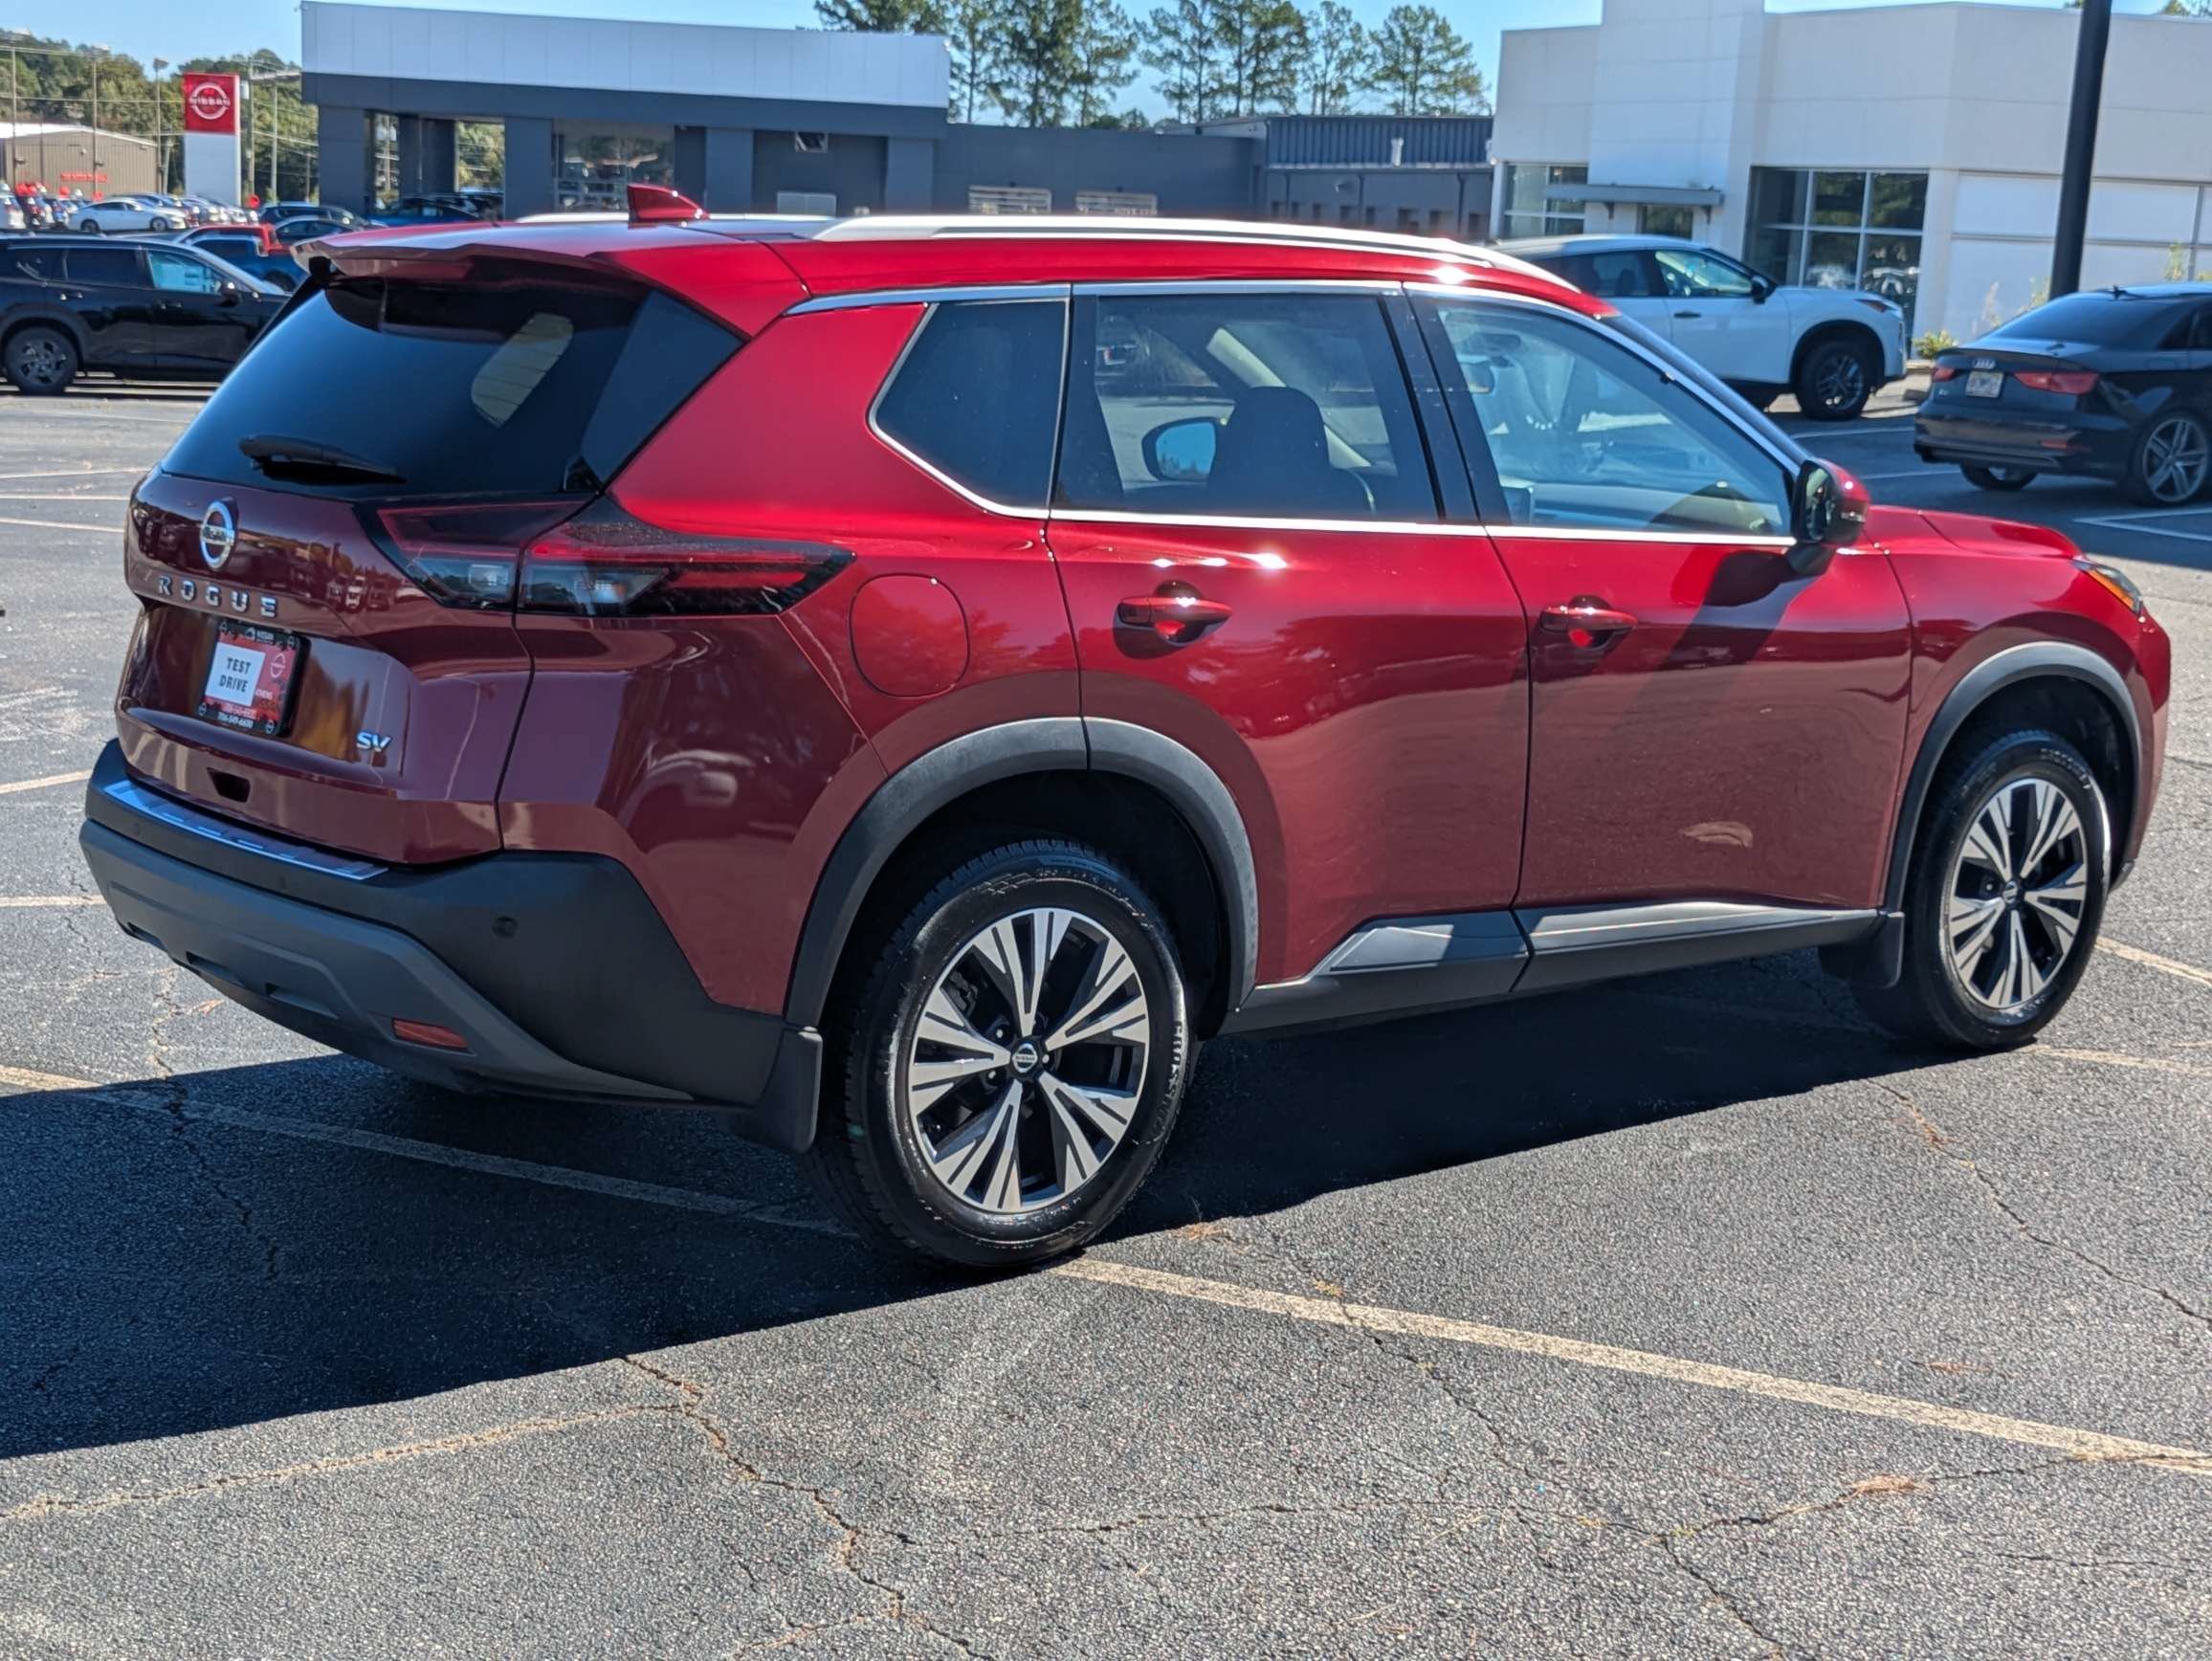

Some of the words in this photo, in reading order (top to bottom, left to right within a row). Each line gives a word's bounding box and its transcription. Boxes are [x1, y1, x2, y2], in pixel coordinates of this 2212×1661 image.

[158, 575, 276, 618] ROGUE
[227, 657, 252, 675] TEST
[219, 675, 249, 693] DRIVE
[356, 731, 391, 753] SV
